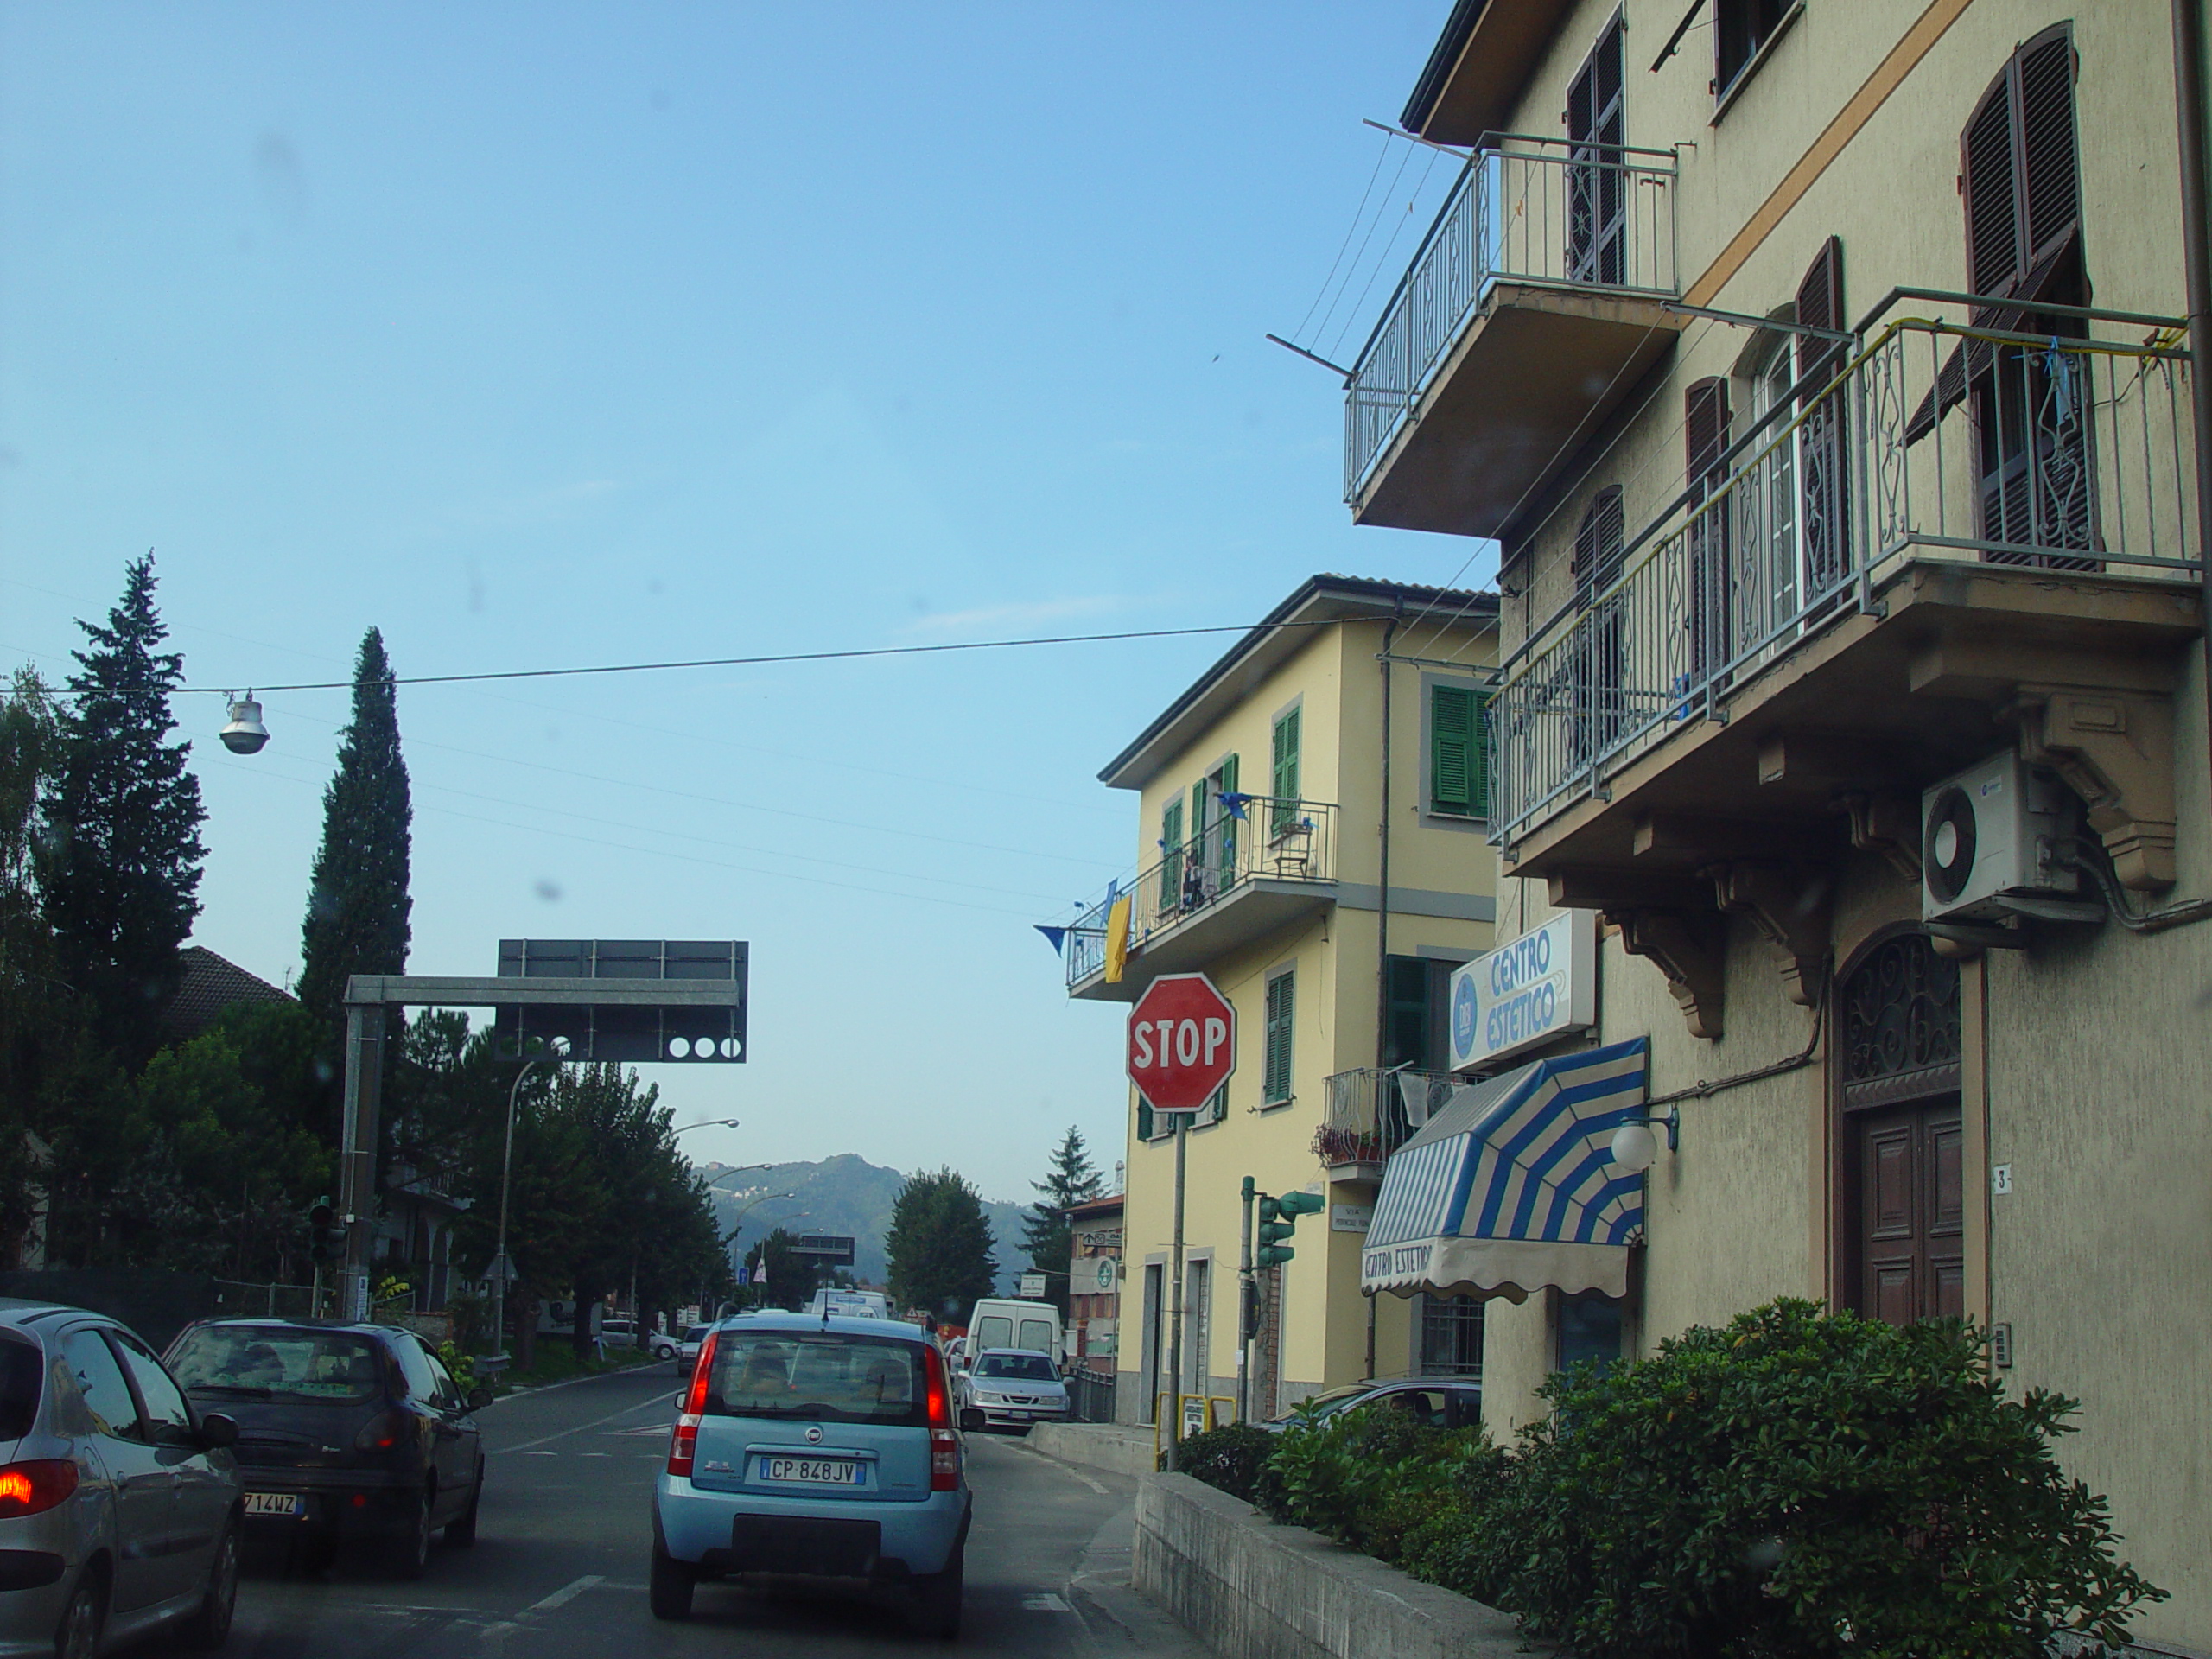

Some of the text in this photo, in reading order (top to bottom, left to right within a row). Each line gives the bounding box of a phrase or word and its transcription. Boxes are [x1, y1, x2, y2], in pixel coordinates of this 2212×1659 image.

[1491, 929, 1551, 997] CENTRO
[1134, 1017, 1227, 1069] STOP
[1487, 982, 1555, 1051] ESTETICO
[1364, 1251, 1392, 1279] CENTRO
